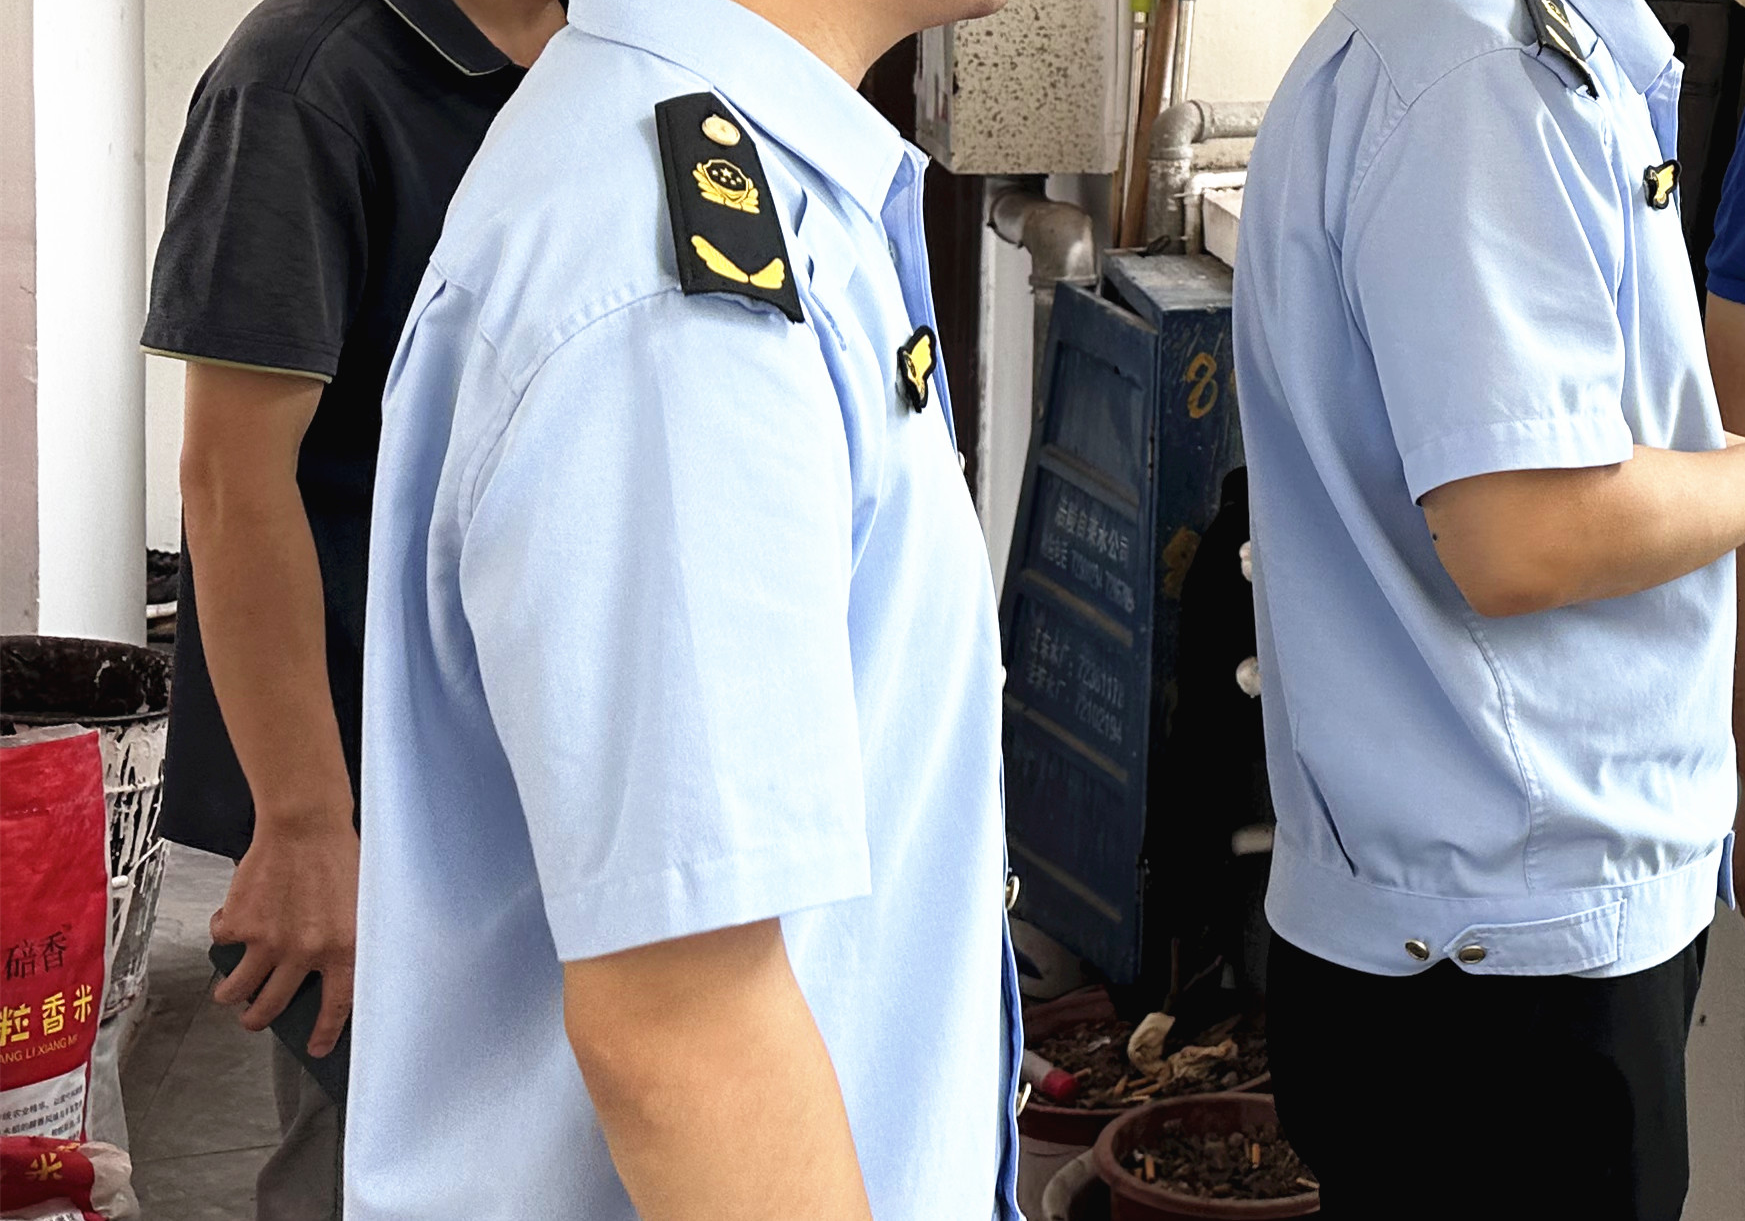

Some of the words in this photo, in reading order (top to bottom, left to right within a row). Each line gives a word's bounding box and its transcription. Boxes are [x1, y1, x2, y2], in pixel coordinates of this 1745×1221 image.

[0, 984, 93, 1047] 粒香米
[25, 1046, 36, 1059] LI
[37, 1035, 67, 1055] XIANG
